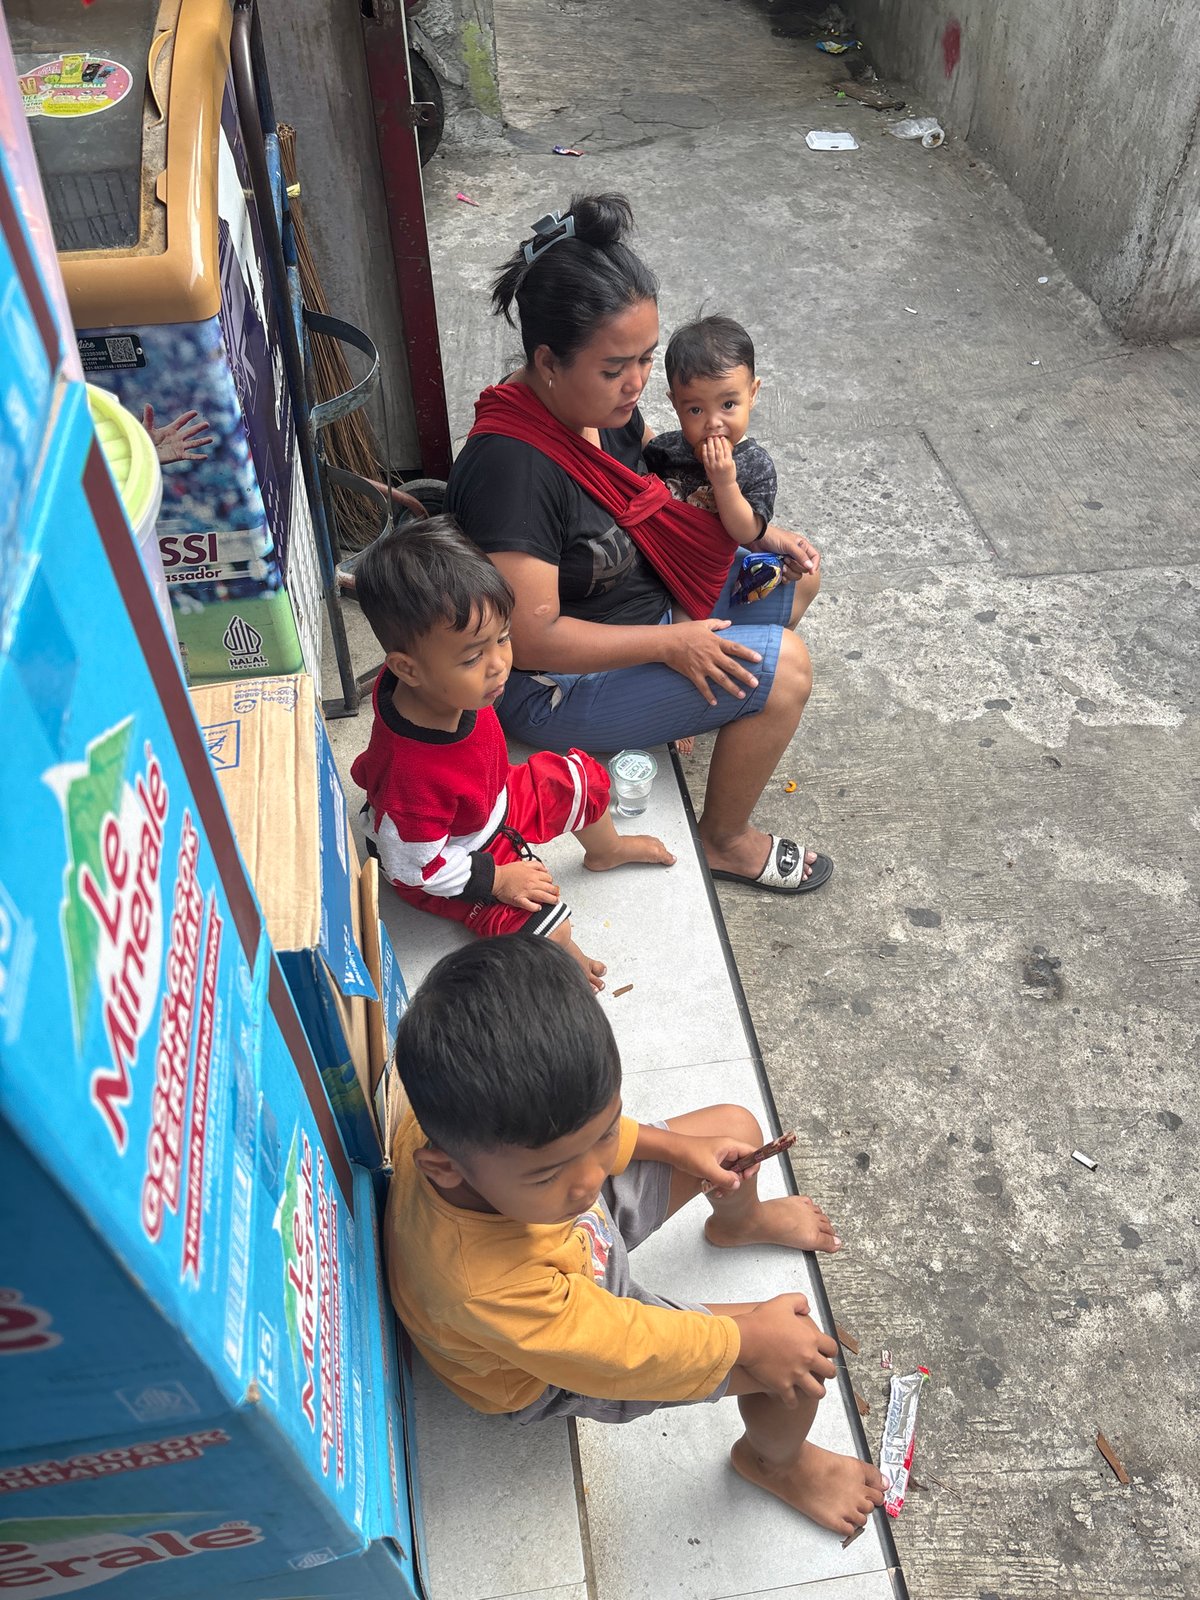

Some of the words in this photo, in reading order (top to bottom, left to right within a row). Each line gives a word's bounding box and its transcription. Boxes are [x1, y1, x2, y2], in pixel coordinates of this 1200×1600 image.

[229, 655, 267, 666] HALAL
[82, 817, 128, 945] Le
[94, 761, 166, 1148] Minerale
[141, 813, 198, 1240] GOSOK-GOSOK
[160, 878, 203, 1209] BERHADIAH
[185, 1131, 202, 1256] Hadiah
[289, 1212, 302, 1296] Le
[302, 1139, 314, 1428] Minerale
